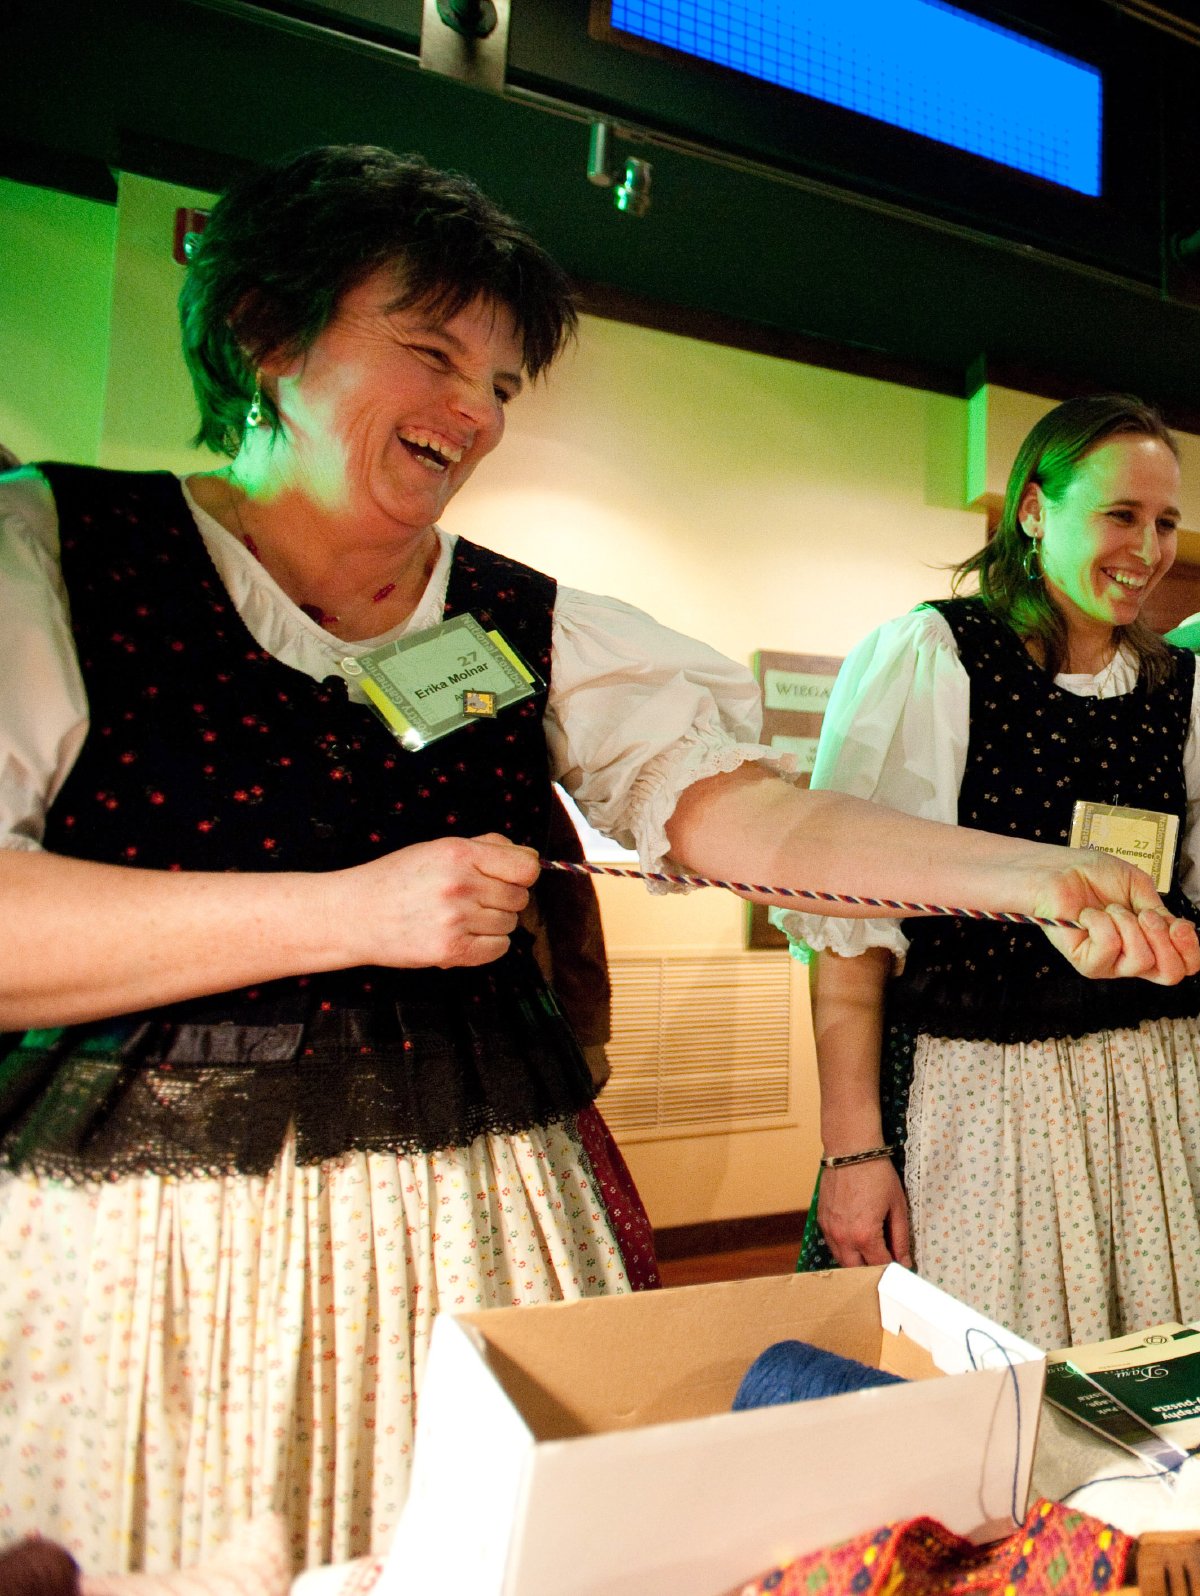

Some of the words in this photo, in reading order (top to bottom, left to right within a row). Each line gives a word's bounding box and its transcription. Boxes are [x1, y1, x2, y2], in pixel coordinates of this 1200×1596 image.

[457, 651, 478, 667] 27
[460, 616, 499, 656] National
[494, 654, 528, 691] Cowboy
[361, 657, 404, 705] Gathering
[414, 679, 448, 700] Erika
[448, 661, 489, 685] Molnar
[1133, 840, 1149, 850] 27
[1156, 816, 1166, 851] National
